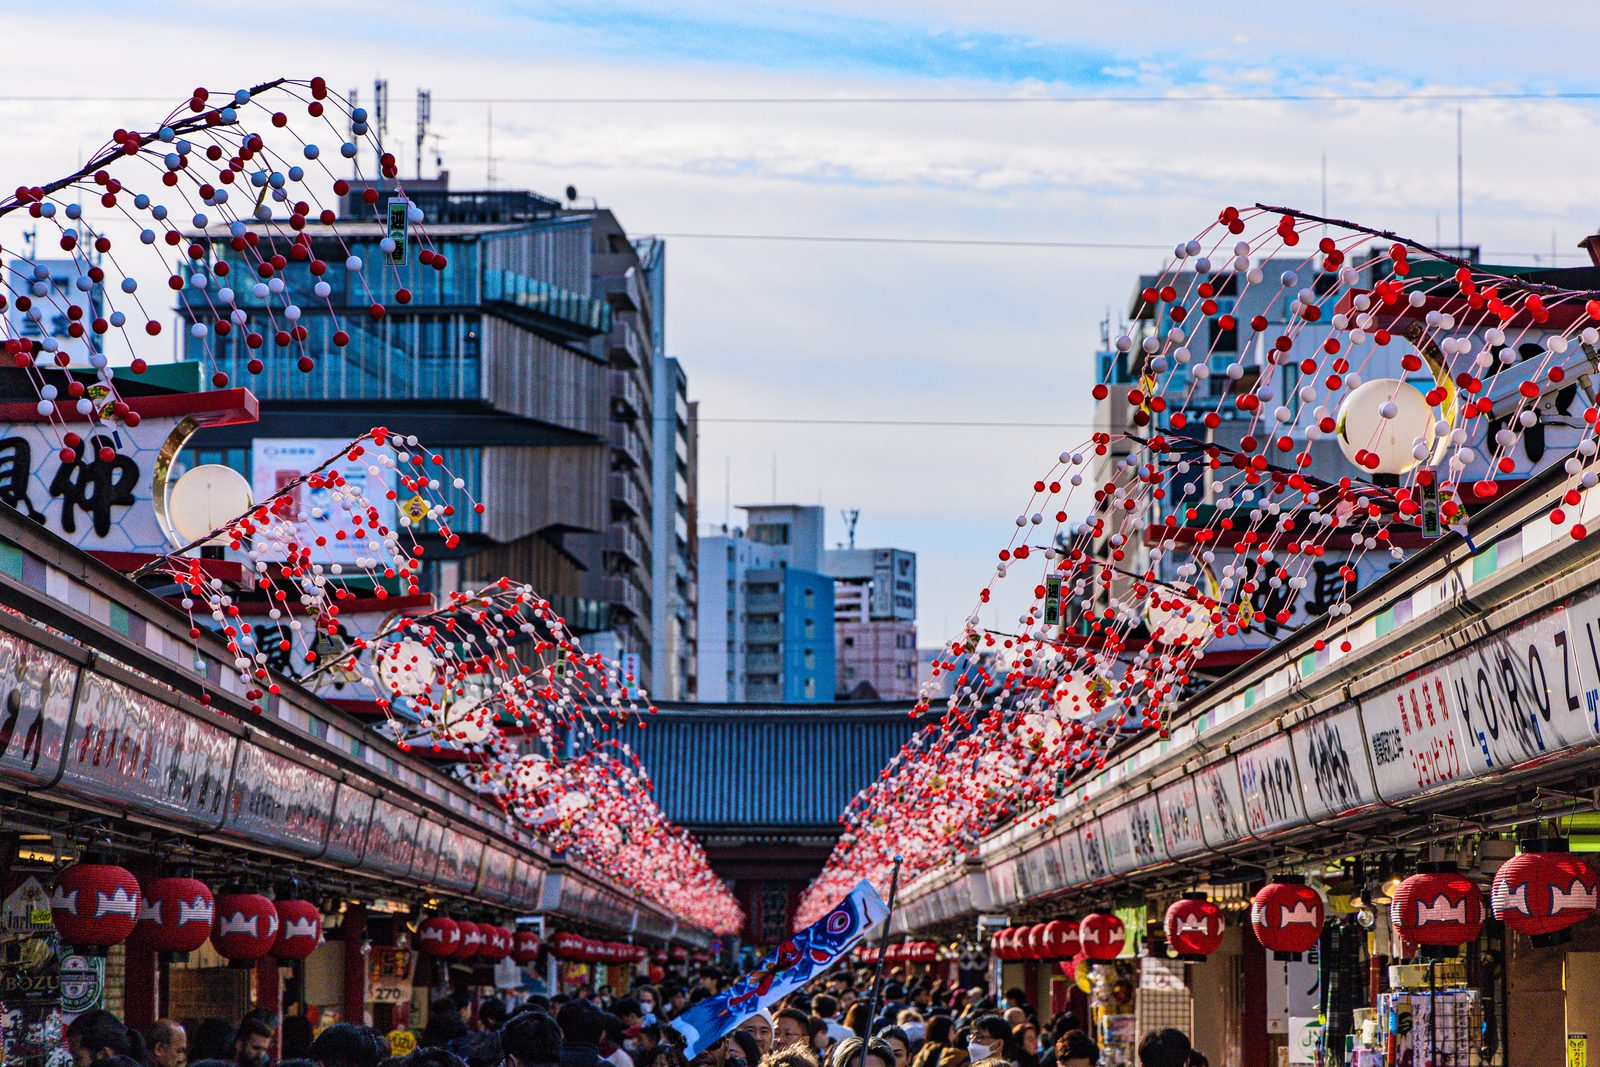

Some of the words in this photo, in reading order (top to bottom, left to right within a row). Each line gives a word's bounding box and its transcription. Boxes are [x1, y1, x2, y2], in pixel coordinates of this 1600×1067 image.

[1409, 730, 1460, 788] ショッピング
